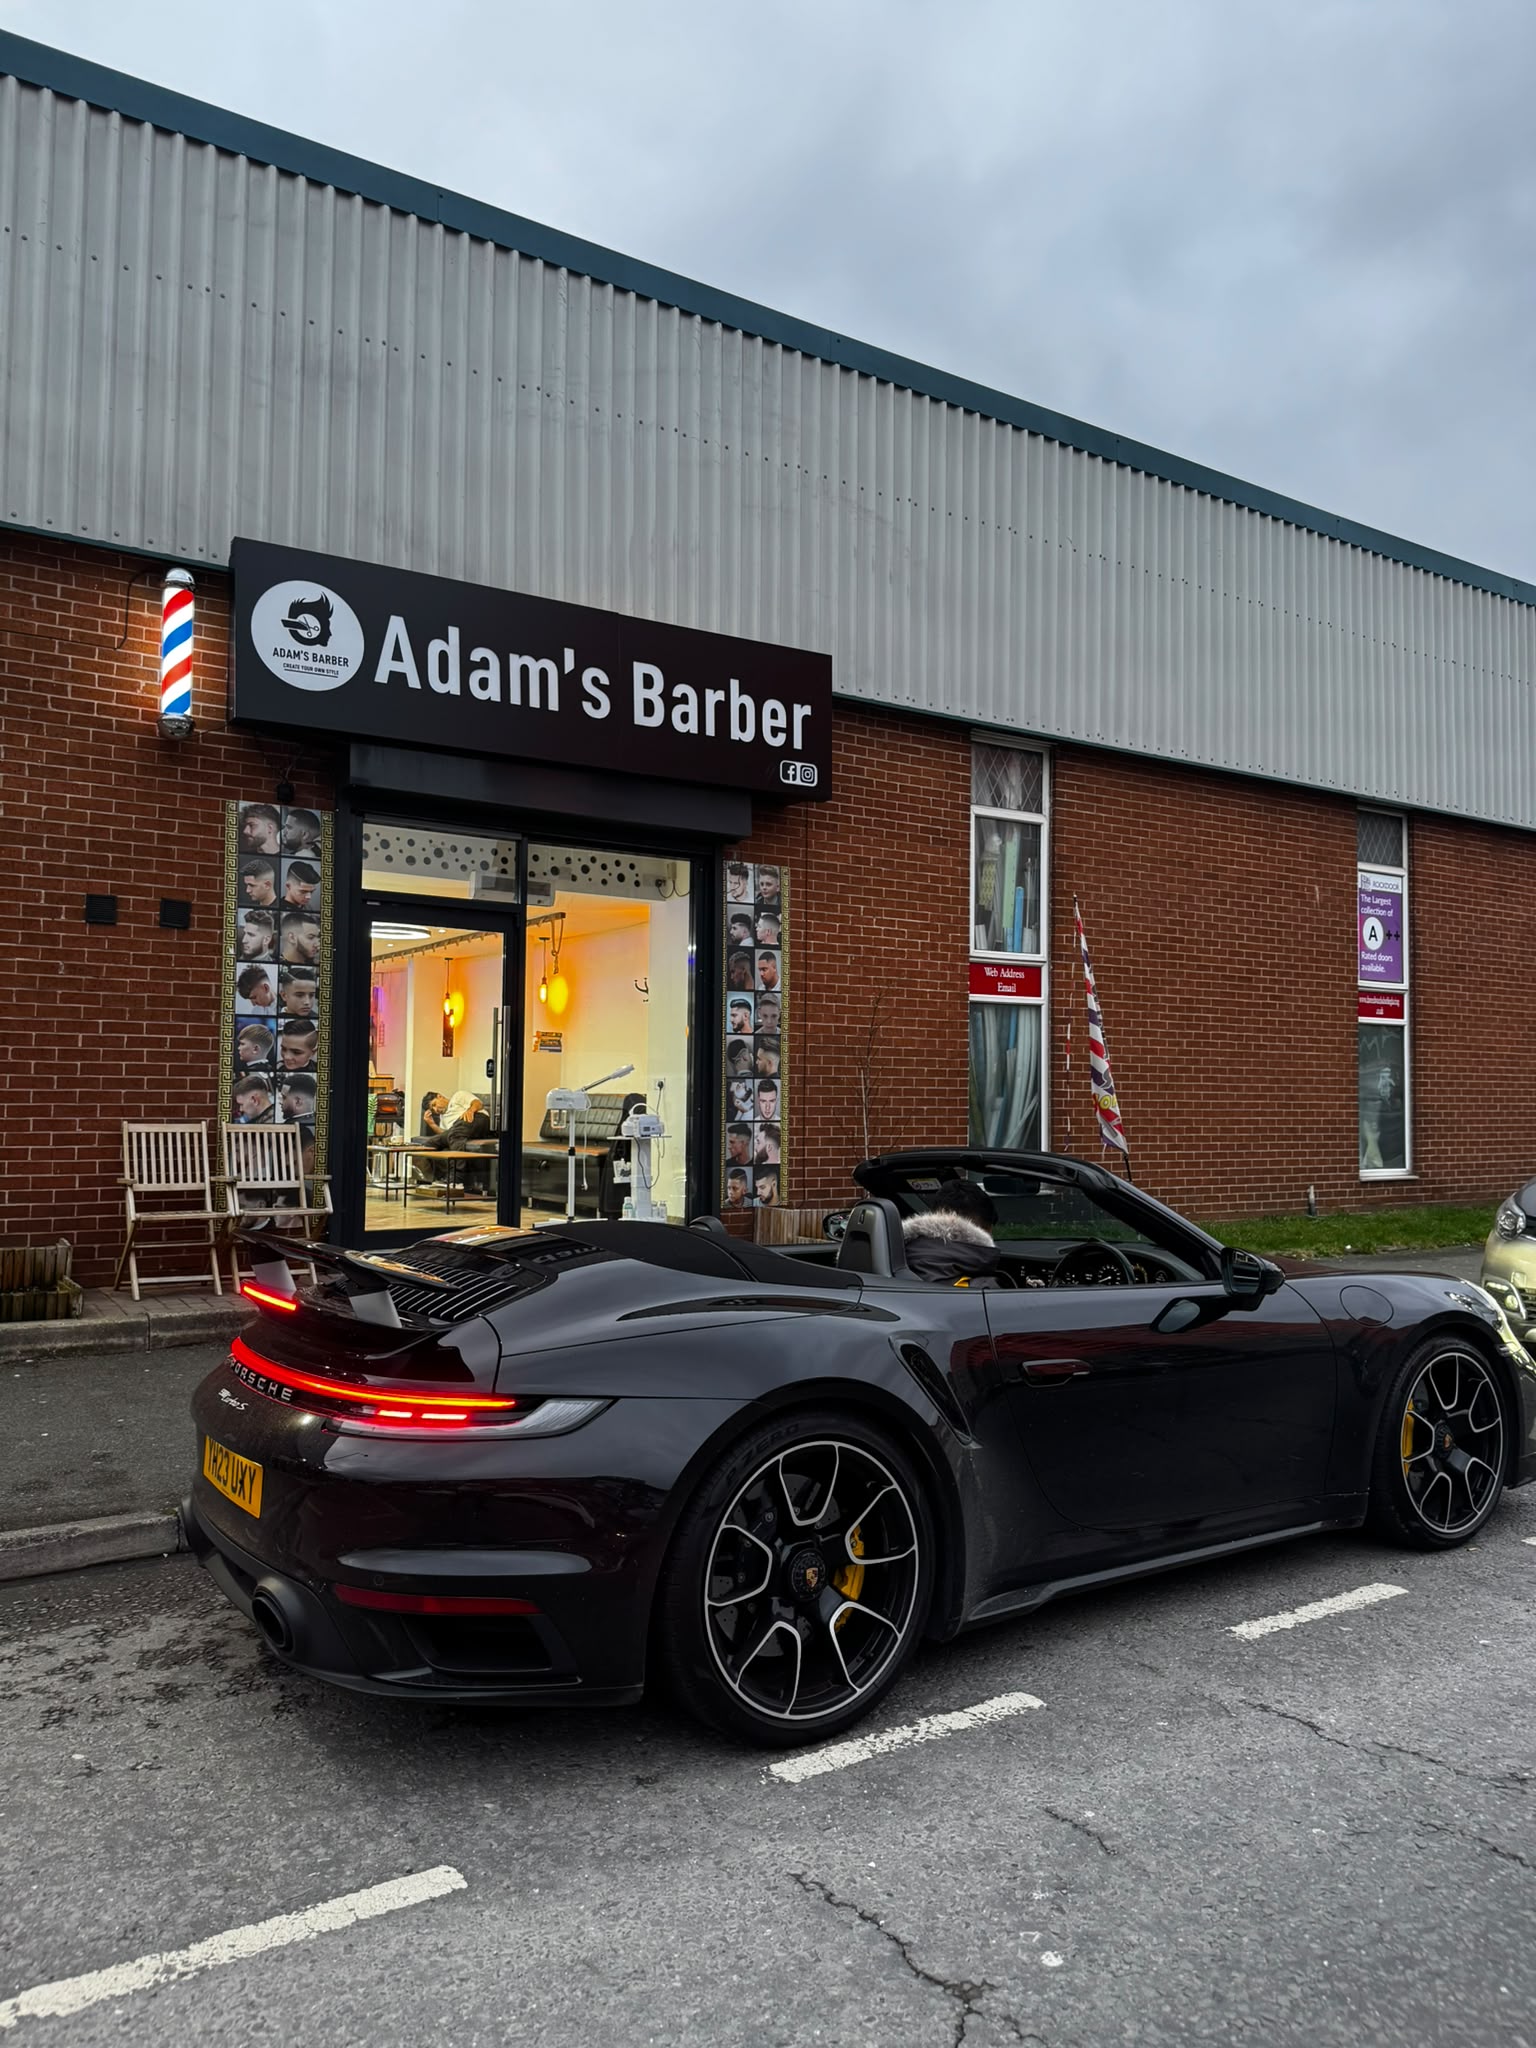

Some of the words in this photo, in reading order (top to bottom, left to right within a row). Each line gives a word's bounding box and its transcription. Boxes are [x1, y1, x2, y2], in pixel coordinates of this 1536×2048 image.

[272, 647, 310, 662] ADAM'S
[312, 652, 349, 668] BARBER
[283, 662, 300, 670] CREATE
[373, 614, 611, 720] Adam's
[632, 660, 812, 751] Barber
[1360, 893, 1371, 903] The
[1372, 896, 1392, 906] Largest
[1360, 906, 1387, 916] collection
[1387, 909, 1394, 917] of
[1361, 951, 1377, 961] Rated
[1378, 953, 1393, 962] doors
[984, 966, 999, 977] Web
[1000, 968, 1025, 979] Address
[997, 982, 1017, 993] Email
[228, 1355, 293, 1401] PORSCHE
[231, 1455, 257, 1505] UXY
